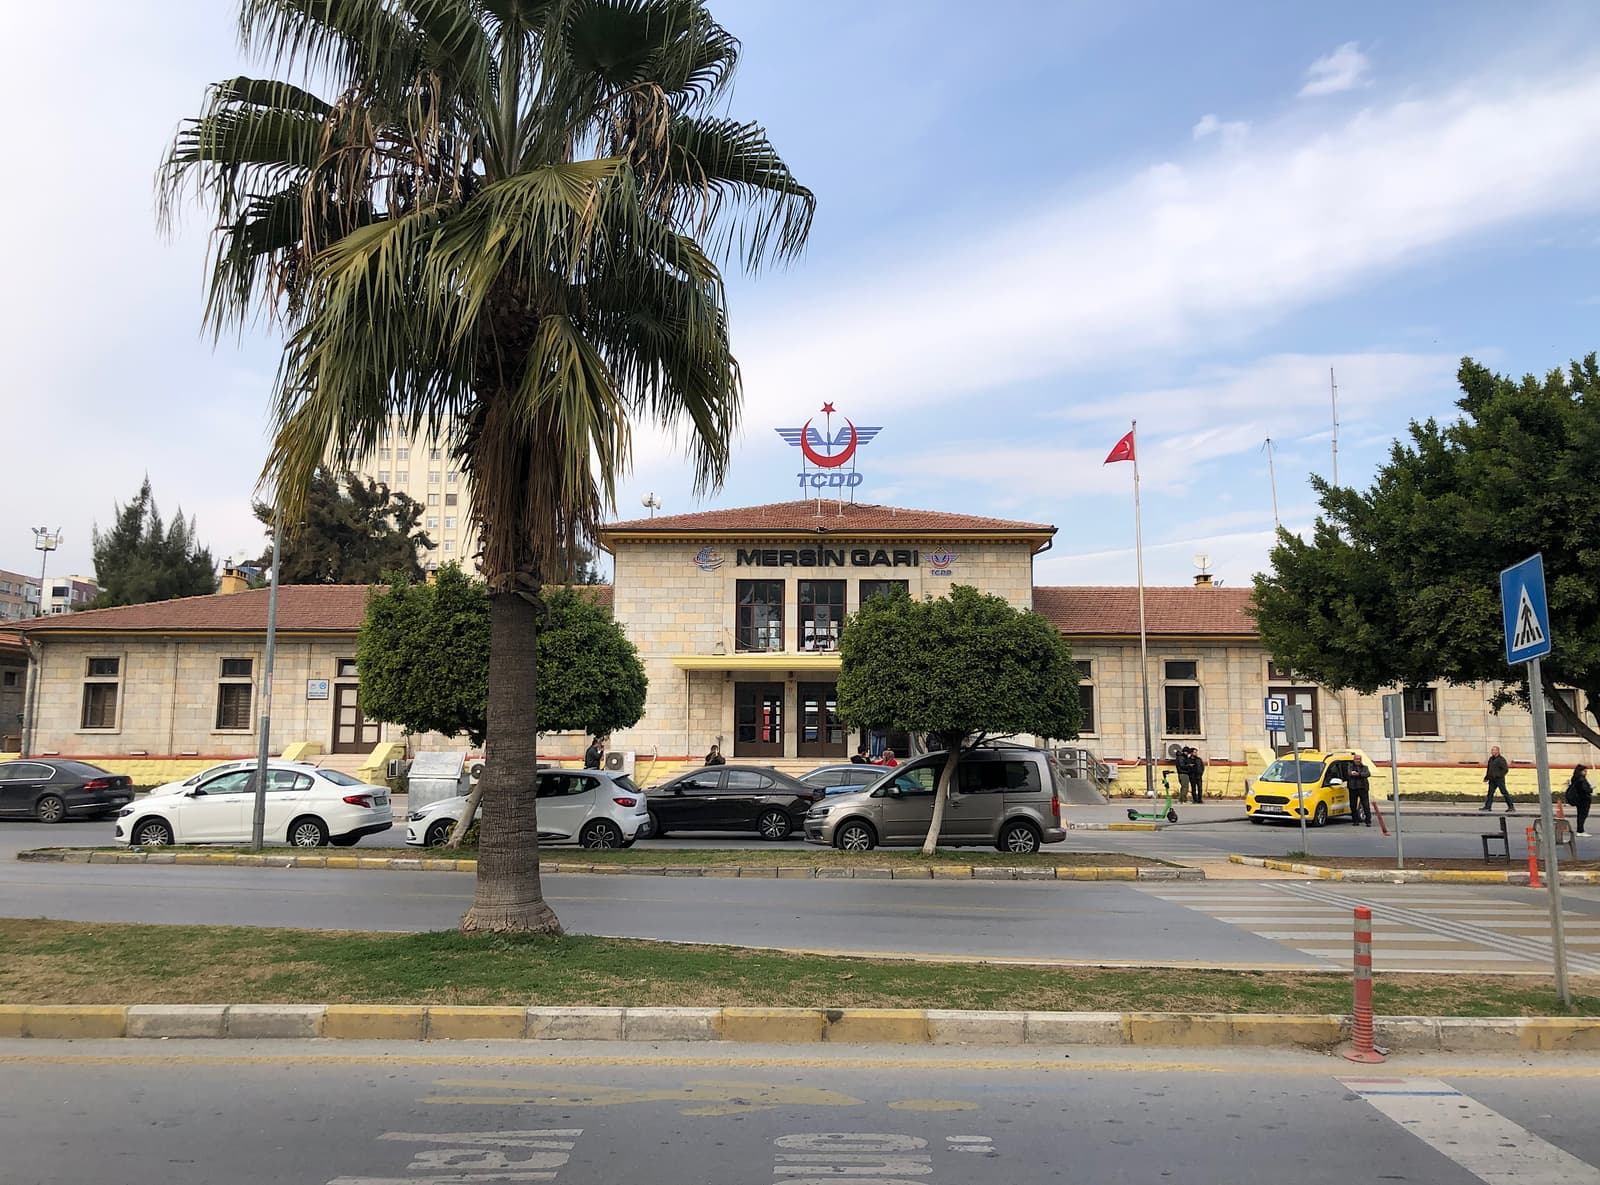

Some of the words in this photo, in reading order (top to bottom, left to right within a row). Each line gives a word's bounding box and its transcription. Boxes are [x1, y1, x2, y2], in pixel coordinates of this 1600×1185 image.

[797, 472, 864, 487] TCDD
[737, 545, 845, 567] MERSİN
[850, 549, 919, 567] GARI
[1271, 701, 1279, 712] D
